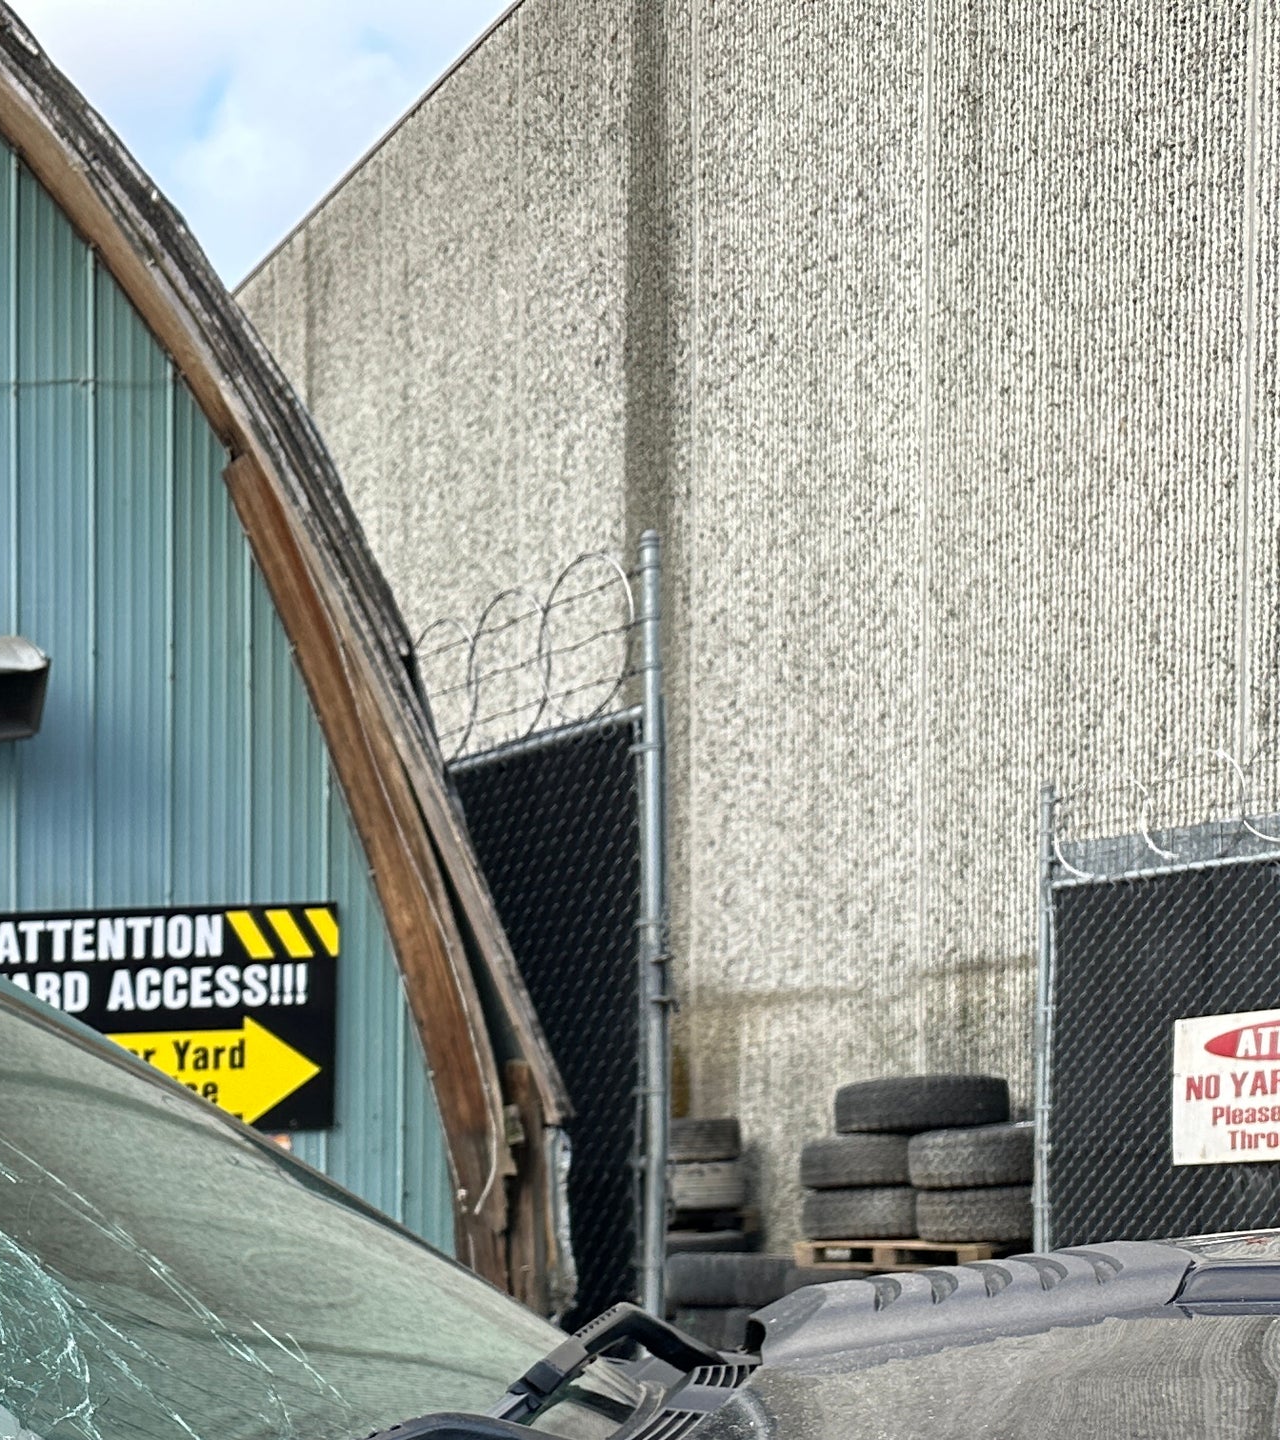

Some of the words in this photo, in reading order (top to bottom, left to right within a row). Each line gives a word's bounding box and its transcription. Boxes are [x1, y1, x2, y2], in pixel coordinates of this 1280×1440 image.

[2, 970, 90, 1013] RD
[106, 962, 309, 1012] ACCESS!!!
[172, 1038, 246, 1071] Yard
[1185, 1074, 1221, 1102] NO
[1212, 1105, 1280, 1127] Please
[1227, 1130, 1280, 1151] Thro
